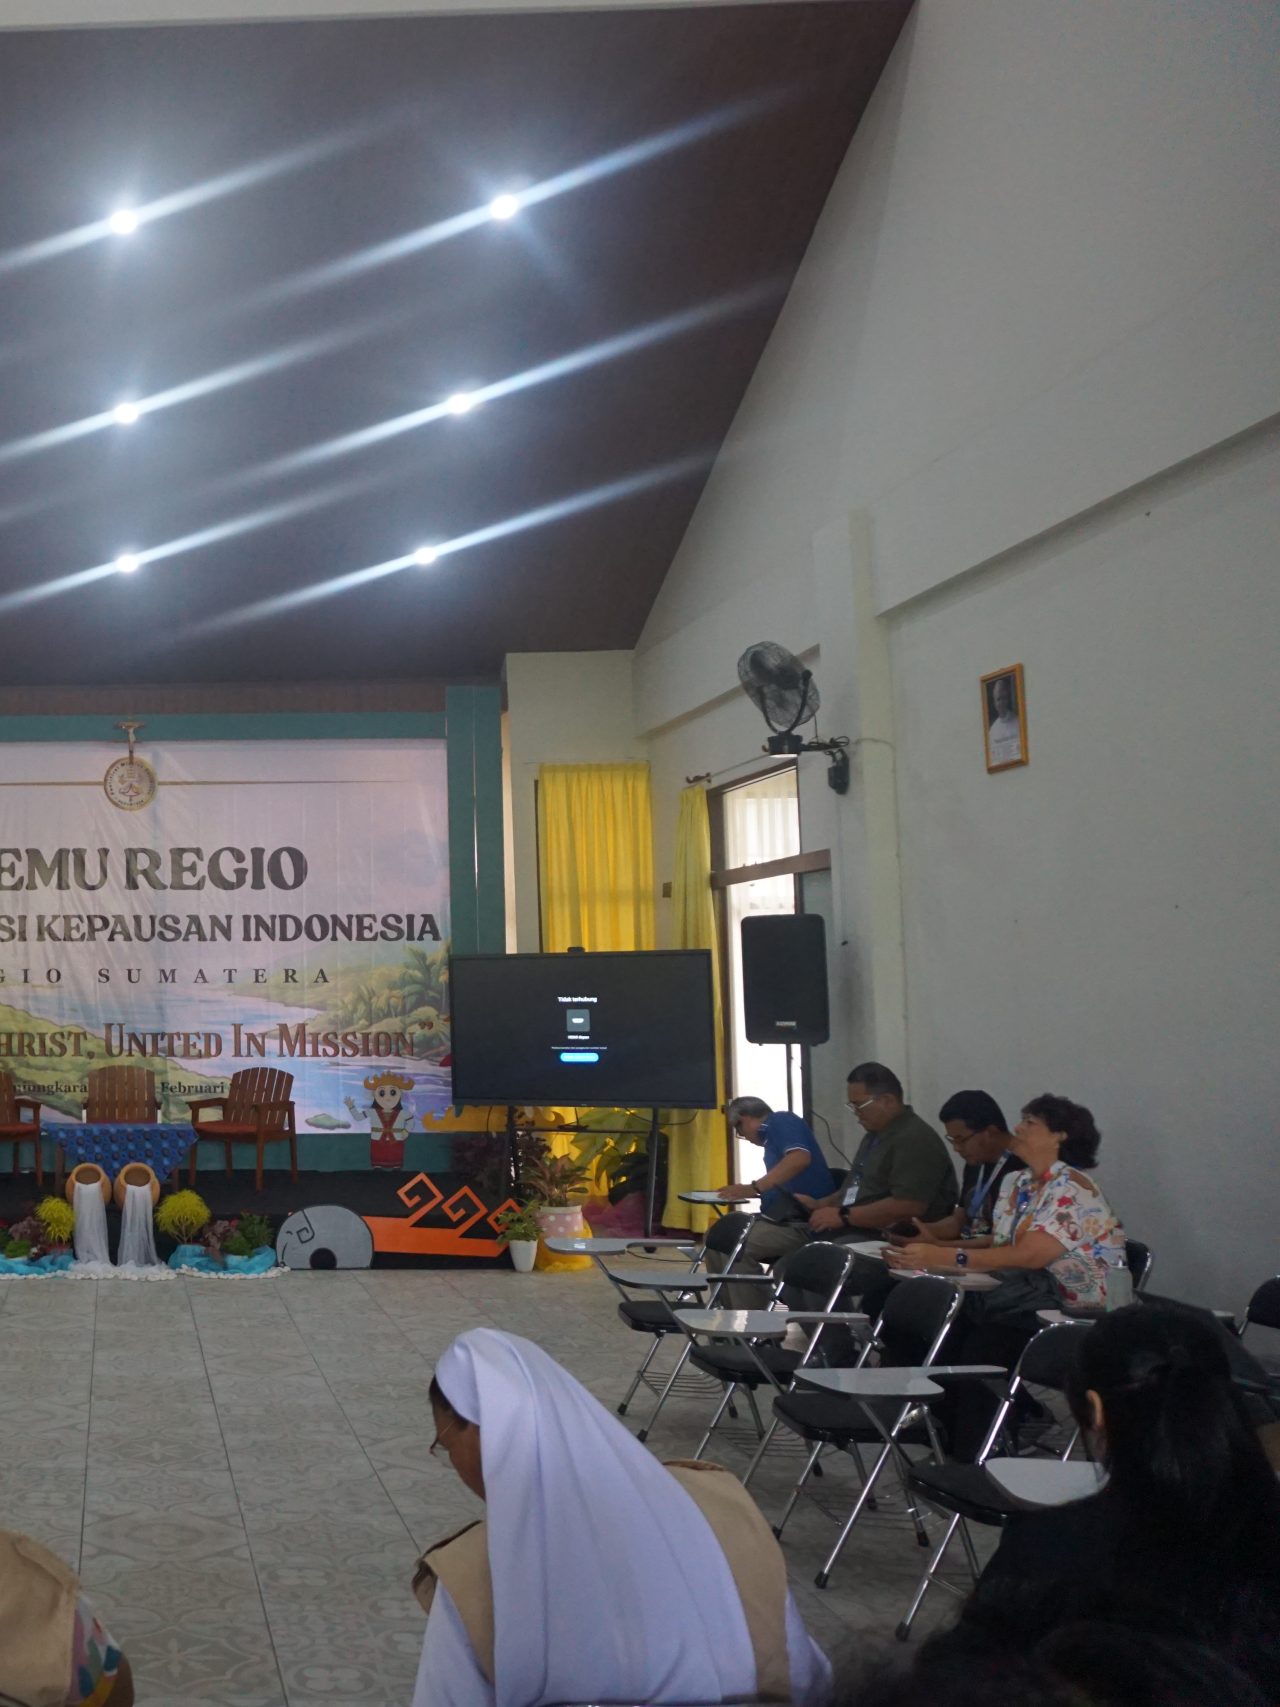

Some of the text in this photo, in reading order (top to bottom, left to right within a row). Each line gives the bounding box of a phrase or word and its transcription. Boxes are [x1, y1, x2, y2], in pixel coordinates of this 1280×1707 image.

[124, 846, 308, 891] REGIO
[36, 914, 233, 942] KEPAUSAN
[242, 913, 442, 942] INDONESIA
[96, 968, 330, 984] SUMATERA
[160, 1081, 225, 1094] Februari
